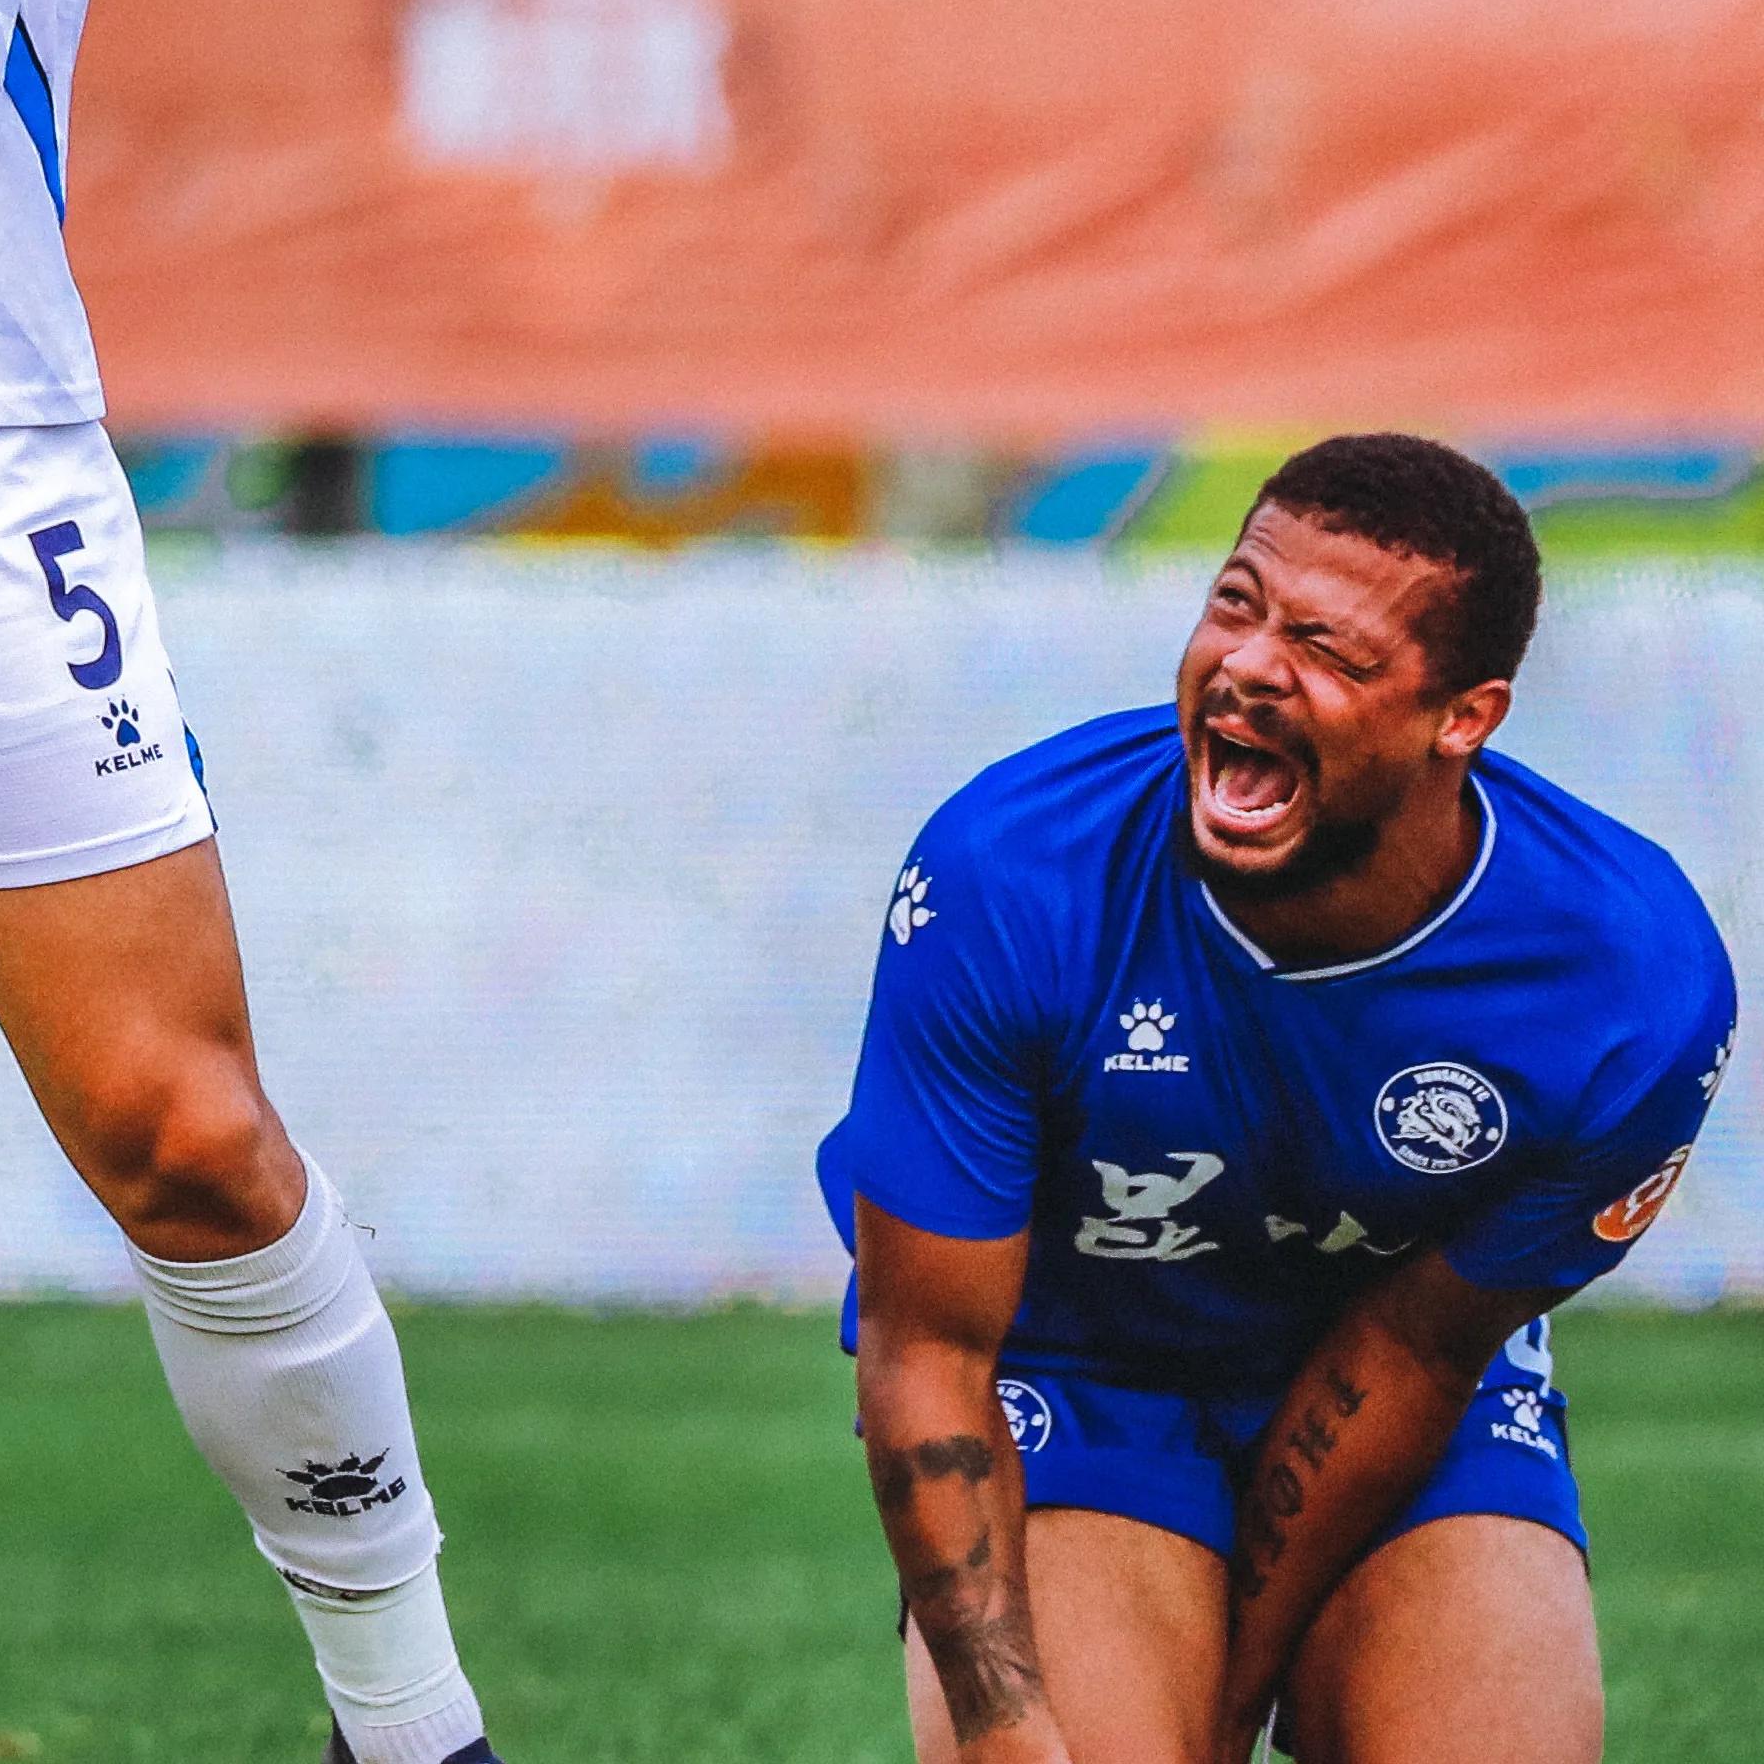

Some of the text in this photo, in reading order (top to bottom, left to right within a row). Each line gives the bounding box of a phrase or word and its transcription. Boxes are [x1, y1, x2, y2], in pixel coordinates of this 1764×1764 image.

[28, 520, 122, 690] 5
[95, 743, 164, 777] KELME
[1103, 1053, 1191, 1073] KELME
[284, 1475, 408, 1517] KELME
